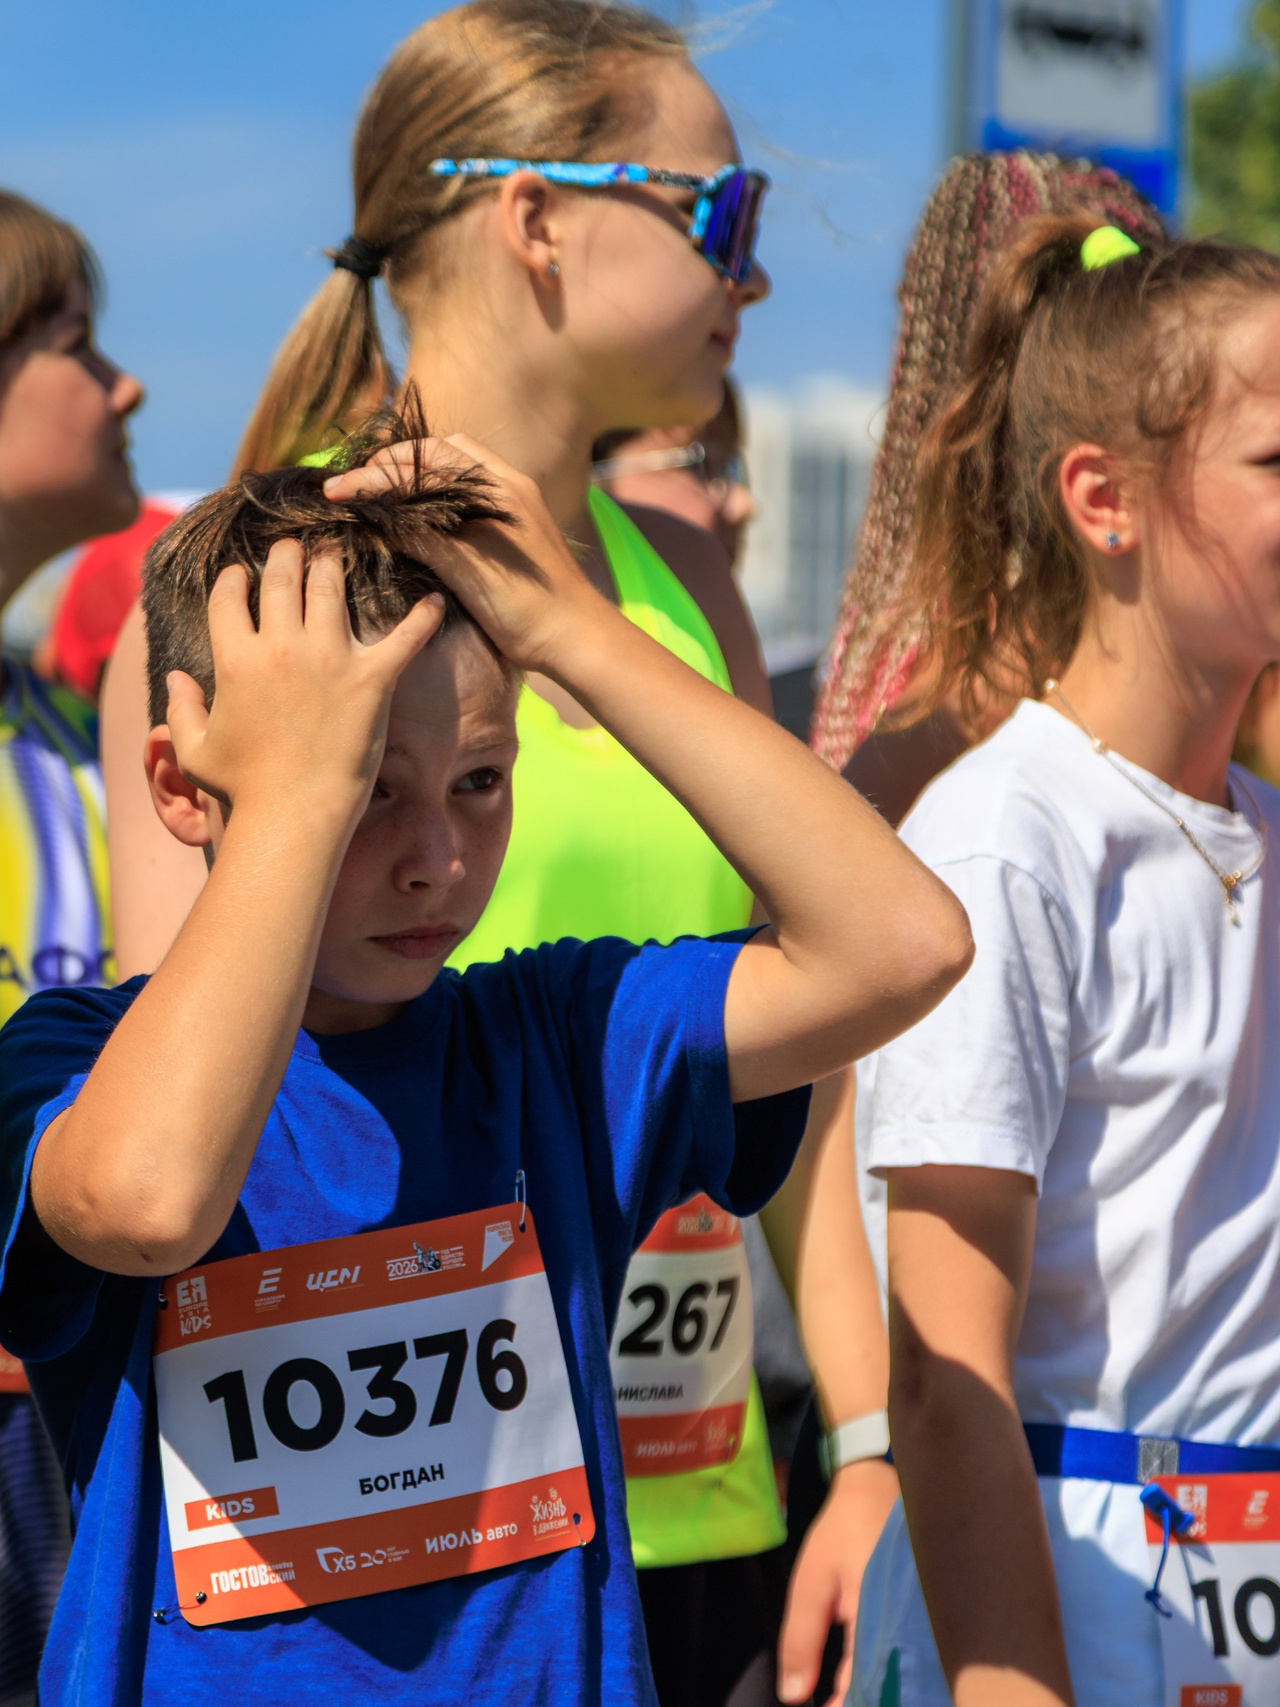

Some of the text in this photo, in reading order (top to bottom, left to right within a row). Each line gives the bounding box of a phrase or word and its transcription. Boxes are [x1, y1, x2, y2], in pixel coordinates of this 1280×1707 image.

[387, 1260, 418, 1277] 2026
[178, 1301, 209, 1314] EUROPE
[179, 1307, 210, 1319] ASIA
[203, 1318, 528, 1463] 10376
[615, 1384, 684, 1401] НИСЛАВА
[358, 1463, 445, 1495] БОГДАН
[206, 1497, 255, 1521] KIDS
[530, 1496, 567, 1523] ЖИЗНЬ
[425, 1528, 483, 1554] ИЮЛЬ
[486, 1523, 518, 1541] авто
[1192, 1577, 1280, 1658] 10
[1195, 1691, 1228, 1705] KIDS
